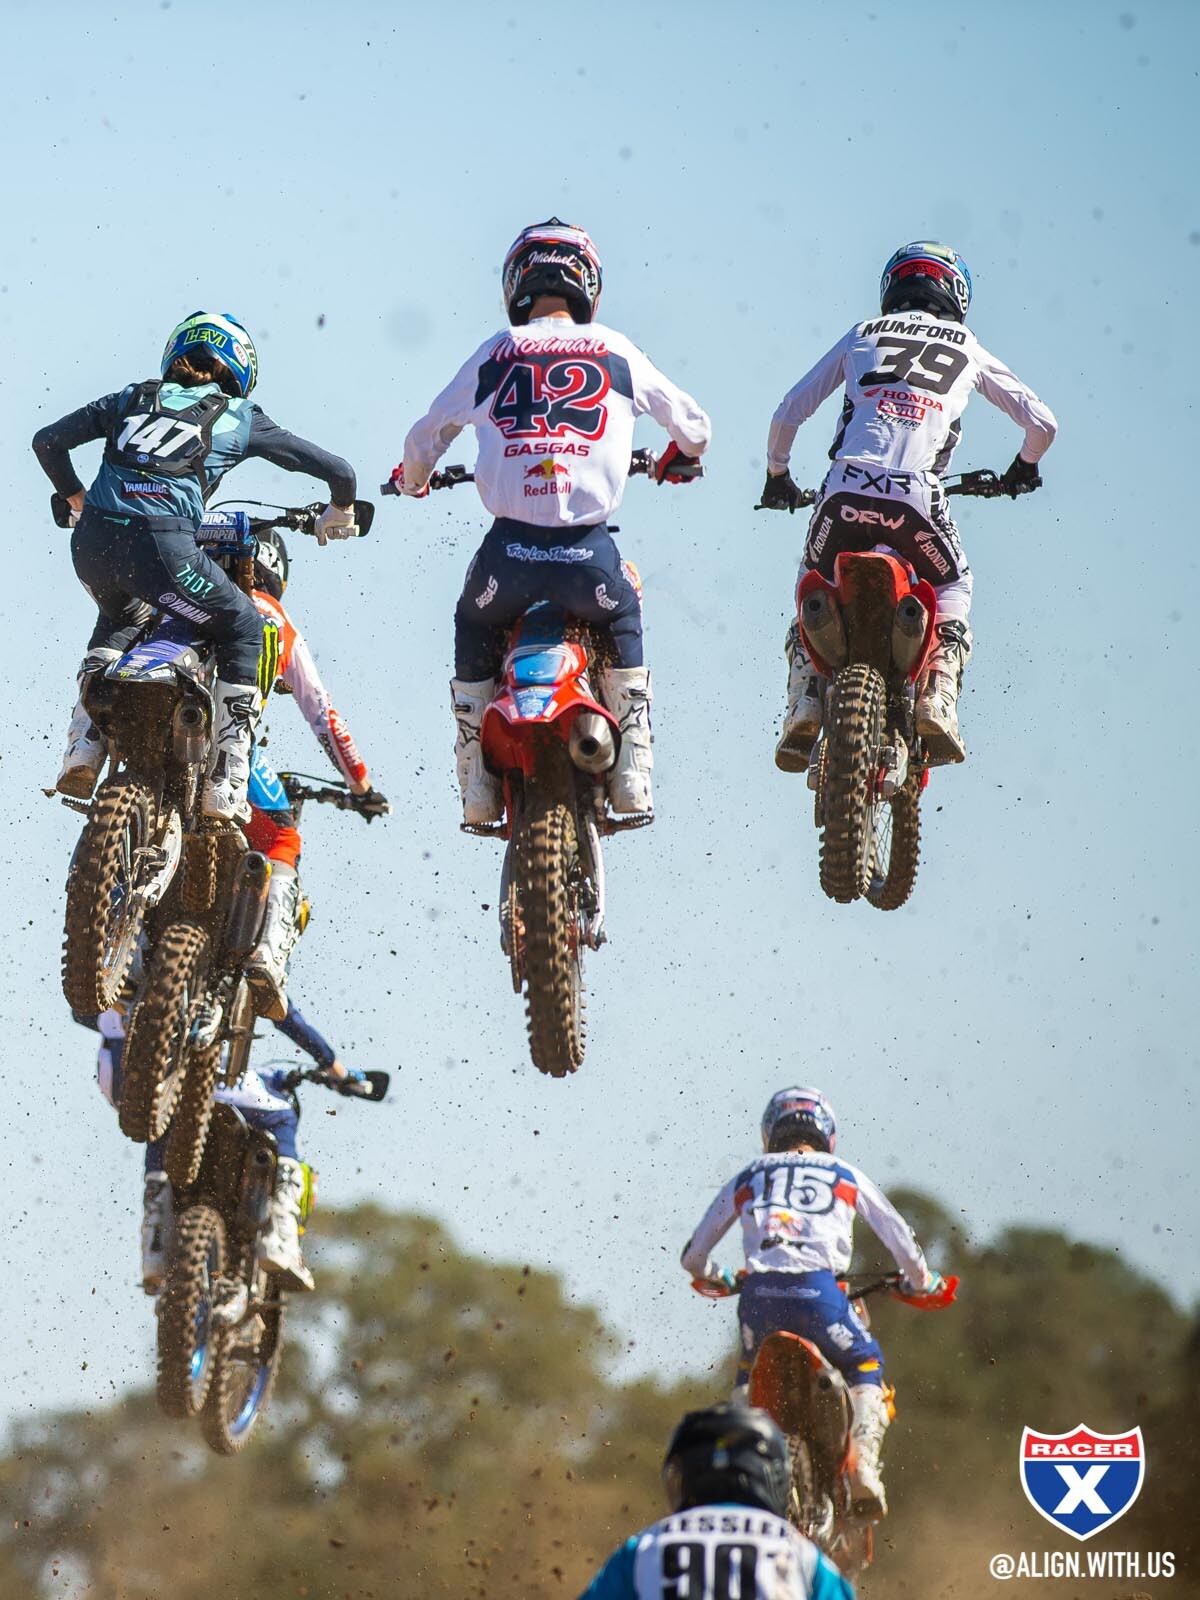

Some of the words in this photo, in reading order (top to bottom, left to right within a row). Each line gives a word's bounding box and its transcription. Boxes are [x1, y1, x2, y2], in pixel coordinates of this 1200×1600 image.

[528, 249, 577, 266] Michael
[184, 328, 228, 348] LEVI
[861, 320, 967, 345] MUMFORD
[490, 336, 608, 361] Mosiman
[858, 337, 969, 396] 39
[489, 358, 611, 441] 42
[882, 390, 943, 412] HONDA
[117, 413, 202, 458] 147
[504, 443, 590, 457] GASGAS
[524, 483, 548, 497] Red
[550, 482, 571, 495] Bull
[841, 463, 911, 495] FXR
[196, 529, 235, 541] ROTAPER
[813, 516, 834, 554] HONDA
[528, 546, 549, 561] Lee
[920, 540, 951, 576] HONDA
[168, 598, 212, 625] YAMAHA
[663, 1542, 758, 1600] 90
